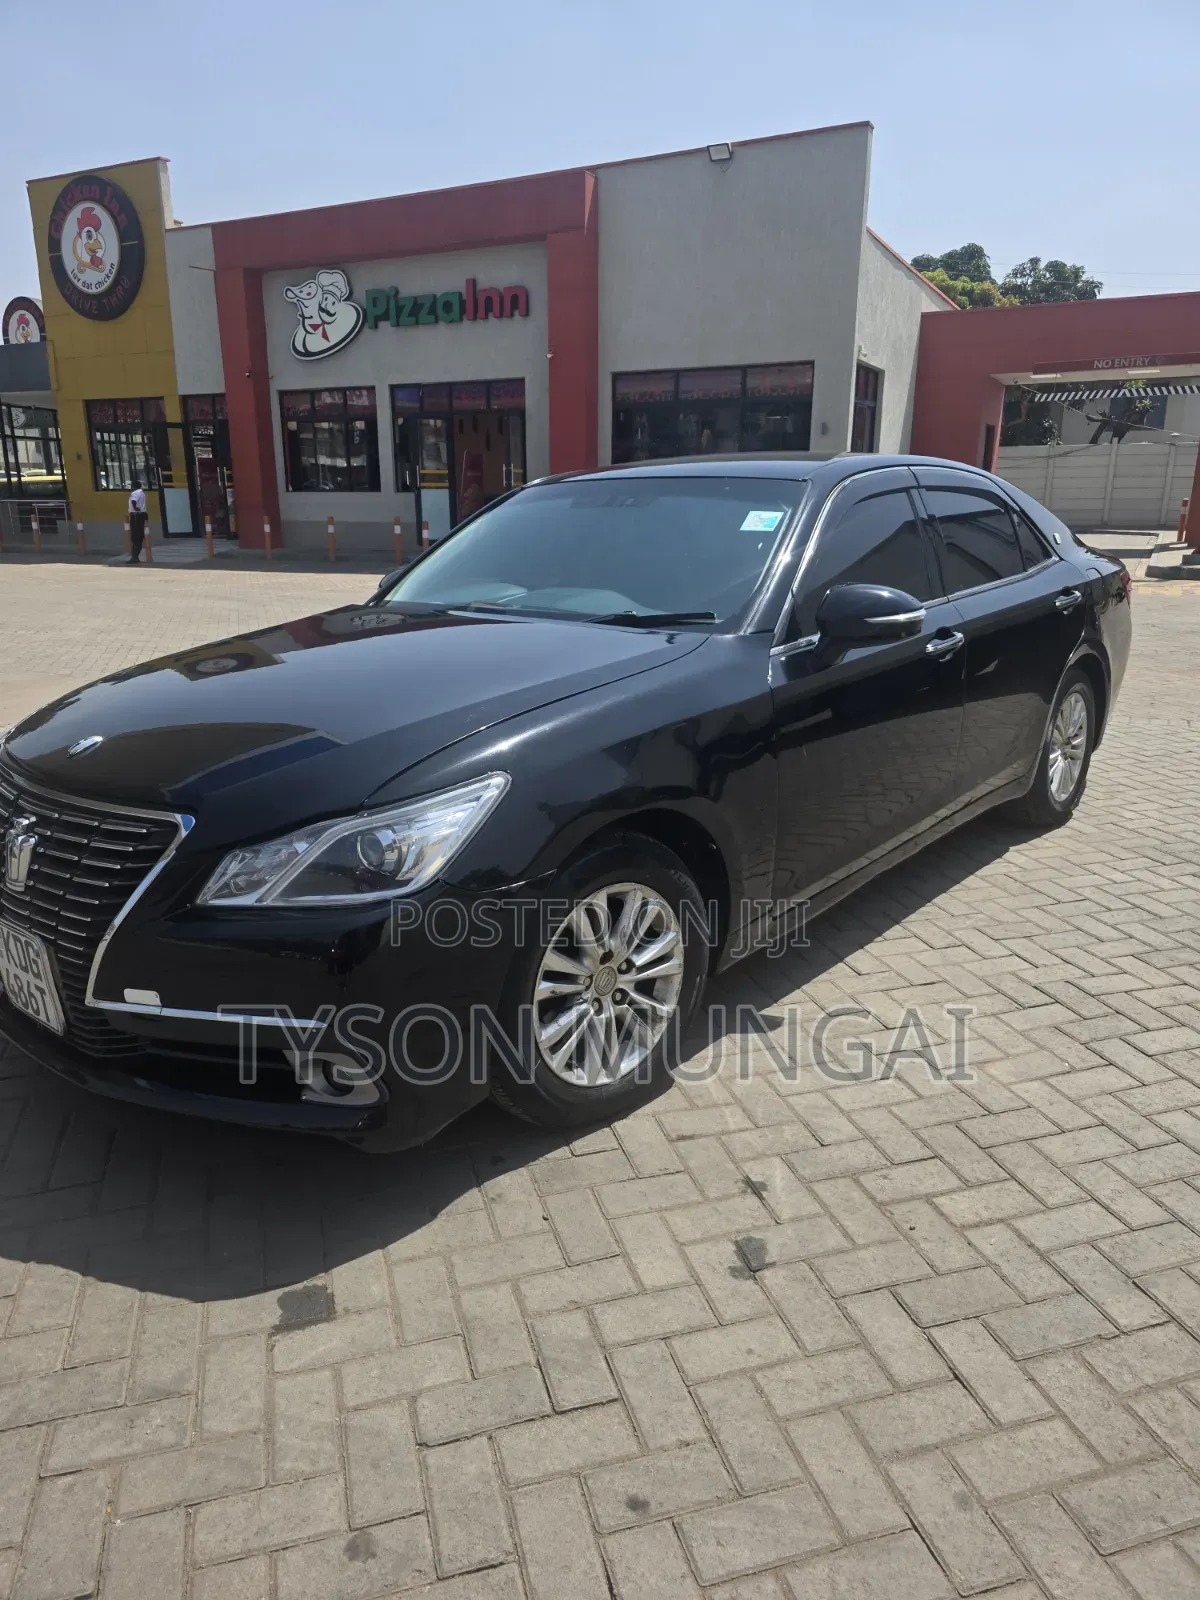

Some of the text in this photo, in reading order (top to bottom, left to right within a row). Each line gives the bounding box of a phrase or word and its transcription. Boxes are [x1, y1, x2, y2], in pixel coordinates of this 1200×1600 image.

[64, 283, 100, 314] DRIVE
[103, 275, 131, 312] THRU
[70, 262, 116, 291] luv dat chicken
[1093, 356, 1151, 369] NO ENTRY
[0, 926, 43, 982] KDG
[6, 967, 51, 1024] 486T
